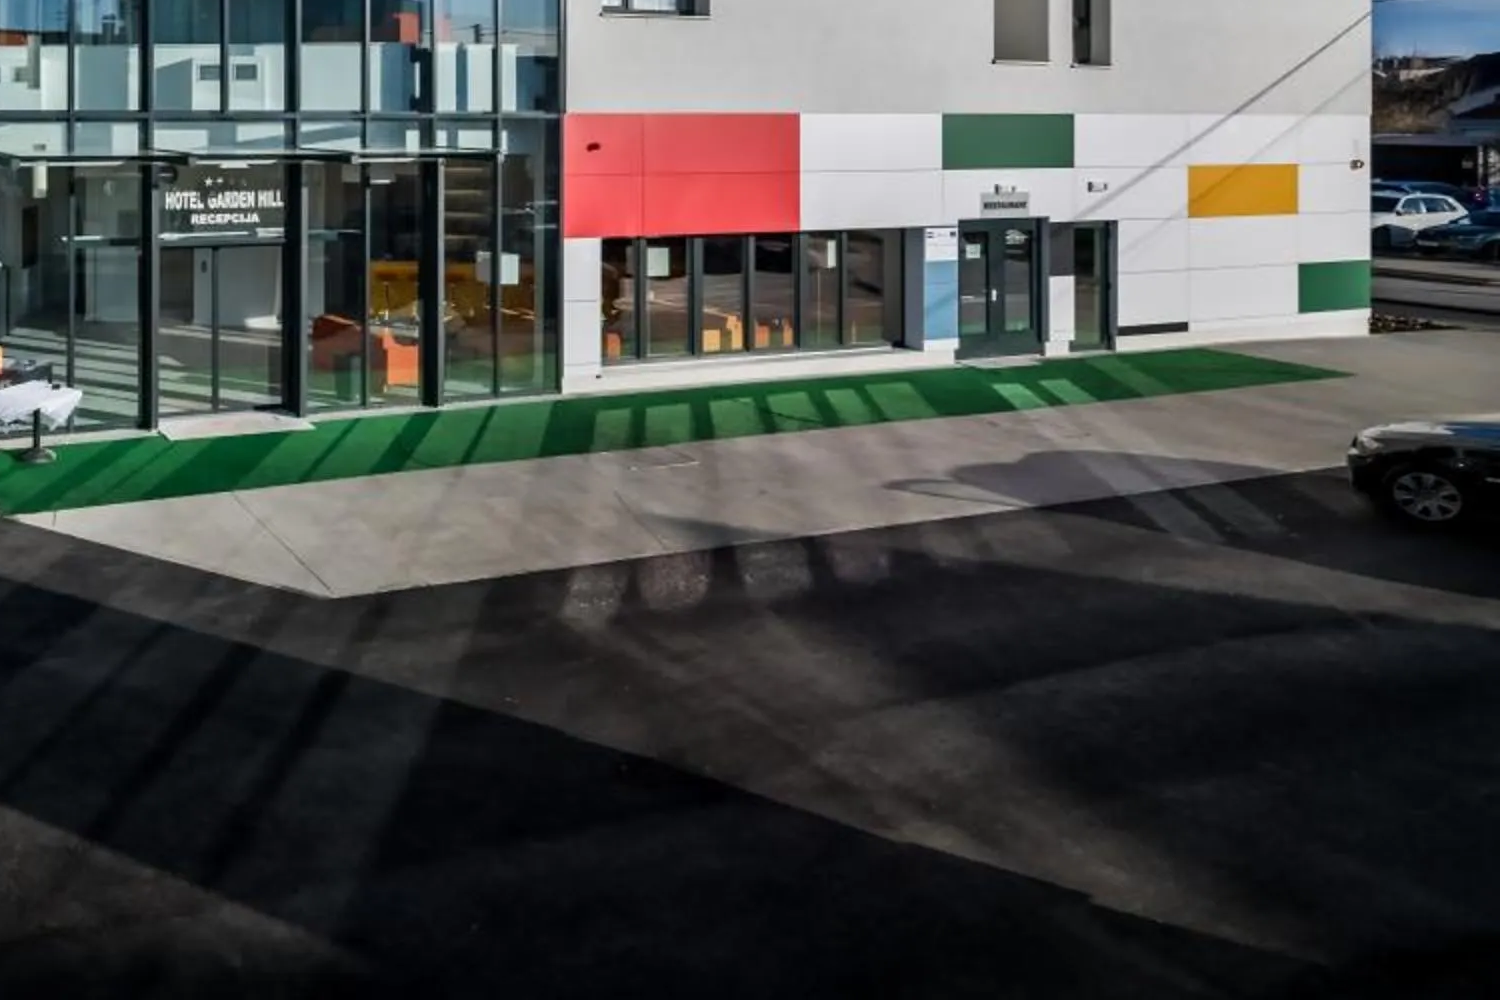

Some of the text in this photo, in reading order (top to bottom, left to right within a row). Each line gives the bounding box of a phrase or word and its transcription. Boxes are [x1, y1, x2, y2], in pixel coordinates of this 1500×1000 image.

[165, 189, 284, 210] HOTEL GARDEN HILL
[191, 212, 260, 225] RECEPCIJA
